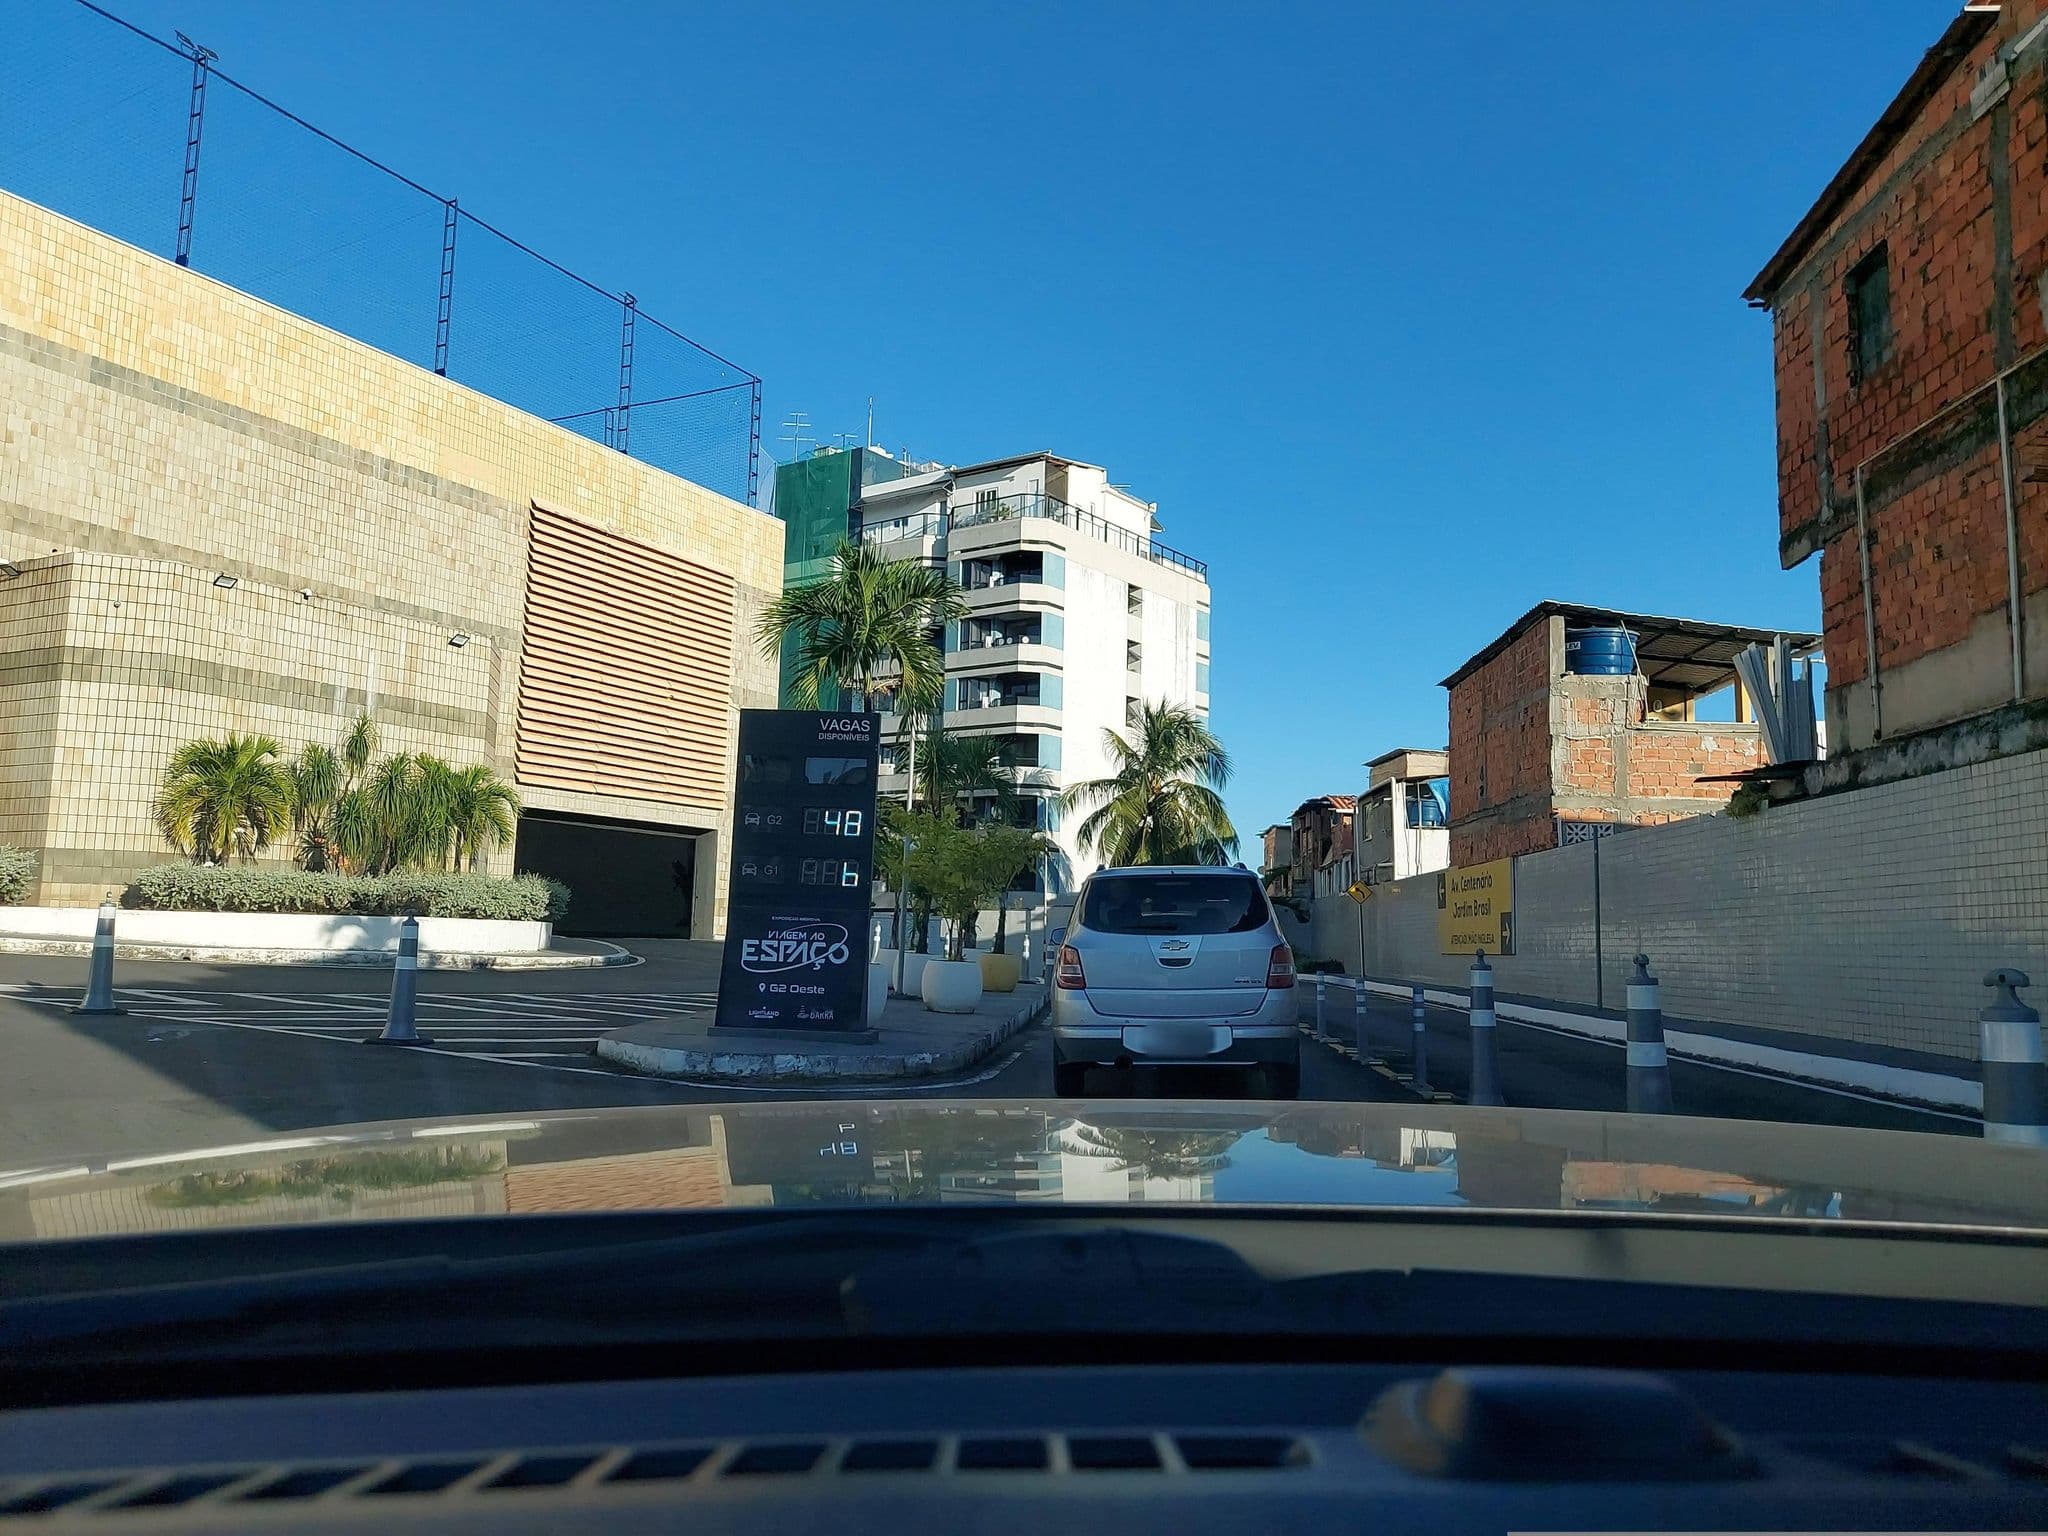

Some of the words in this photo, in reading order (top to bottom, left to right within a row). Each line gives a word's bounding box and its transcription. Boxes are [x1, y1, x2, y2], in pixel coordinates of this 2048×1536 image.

[819, 718, 871, 732] VAGAS
[818, 732, 870, 742] DISPONÍVEIS
[767, 815, 782, 825] G2
[824, 810, 862, 836] 48
[764, 864, 778, 875] G1
[1460, 870, 1493, 893] Centenário
[1452, 901, 1473, 919] Jardim
[1473, 897, 1491, 916] Brasil
[768, 930, 807, 940] VIAGEM
[810, 932, 825, 941] AO
[742, 939, 849, 970] ESPAÇO
[769, 983, 787, 993] G2
[790, 984, 825, 995] Oeste
